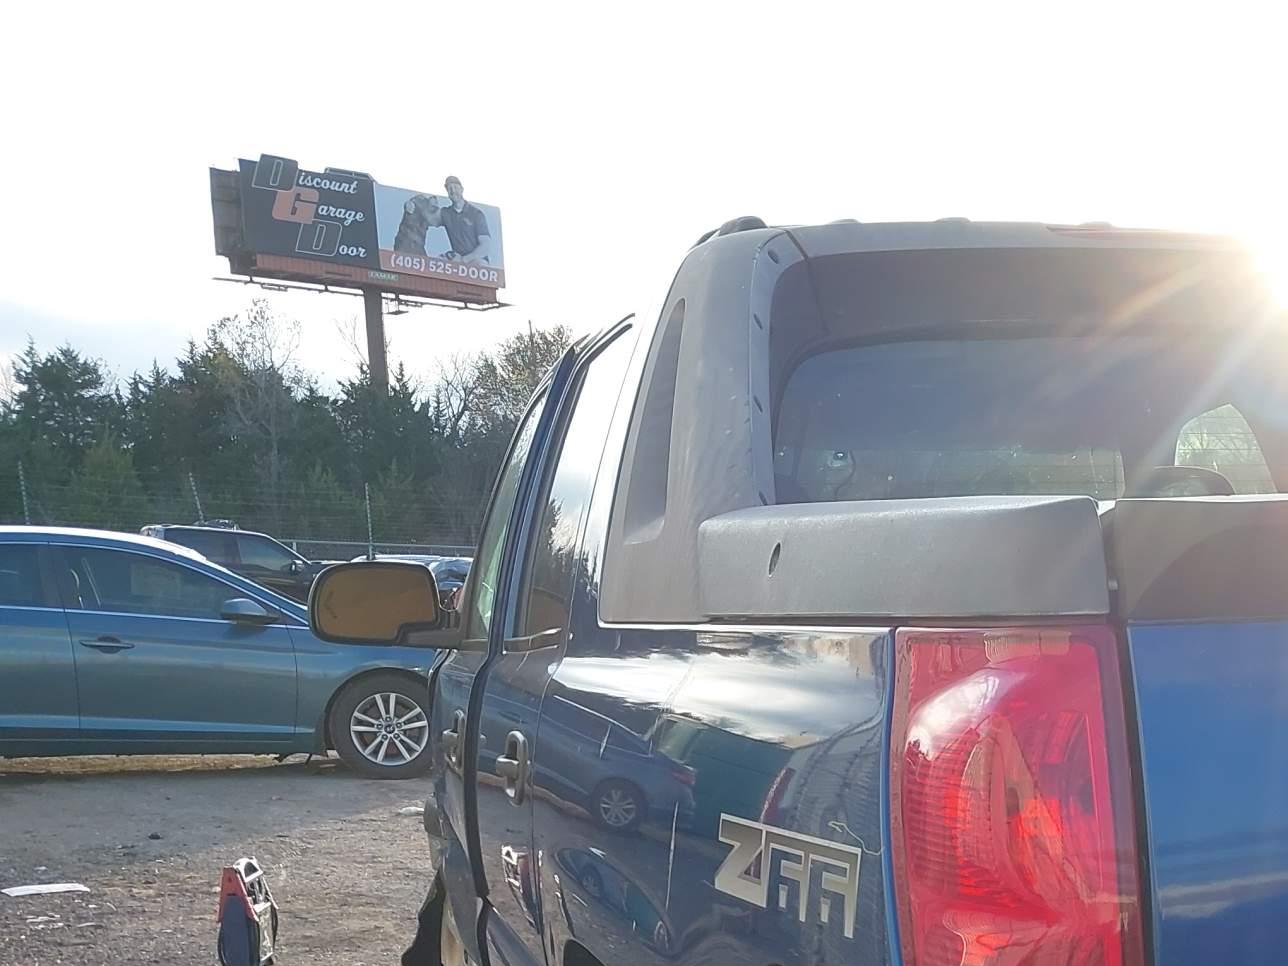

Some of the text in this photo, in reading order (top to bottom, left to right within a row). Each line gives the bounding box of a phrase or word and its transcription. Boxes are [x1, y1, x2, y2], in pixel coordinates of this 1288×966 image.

[251, 153, 358, 194] Discount
[272, 185, 366, 226] Garage
[295, 218, 367, 258] Door
[391, 253, 499, 283] (405) 525-DOOR
